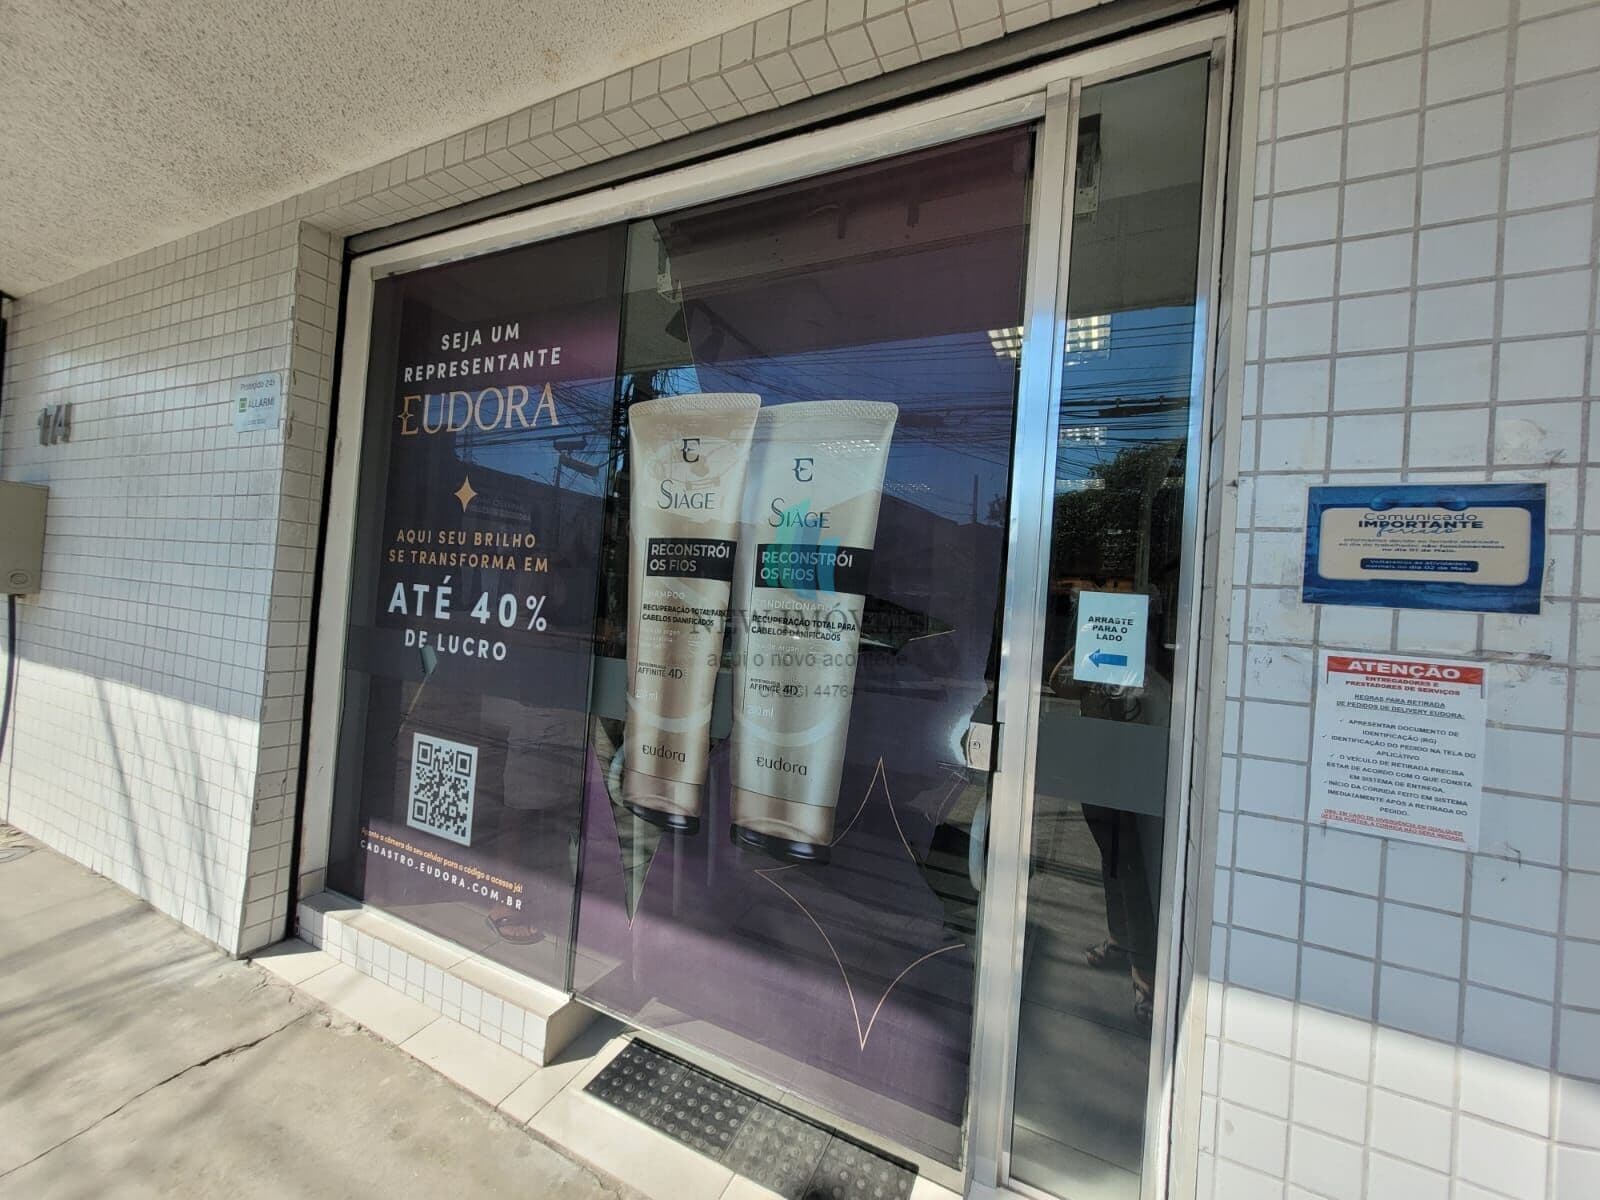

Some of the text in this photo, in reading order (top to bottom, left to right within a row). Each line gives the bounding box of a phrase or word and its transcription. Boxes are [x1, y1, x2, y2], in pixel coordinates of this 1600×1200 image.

[441, 323, 520, 351] SEJA UM
[404, 346, 562, 382] REPRESENTANTE
[398, 382, 560, 435] EUDORA
[1358, 520, 1484, 529] IMPORTANTE
[1364, 512, 1477, 521] Comunicado
[396, 529, 536, 549] AQUI SEU BRILHO
[650, 543, 730, 559] RECONSTRÓI
[389, 550, 548, 573] SE TRANSFORMA EM
[650, 559, 697, 572] OS FIOS
[761, 551, 853, 568] RECONSTRÓI
[760, 568, 815, 582] OS FIOS
[388, 576, 547, 632] ATÉ 40%
[812, 620, 836, 630] TOTAL
[838, 623, 856, 632] PARA
[1088, 616, 1134, 626] ARRASTE
[1092, 624, 1117, 633] PARA
[404, 629, 507, 661] DE LUCRO
[1096, 634, 1123, 642] LADO
[1348, 660, 1461, 681] ATENÇÃO
[1346, 681, 1402, 690] PRESTADORES
[1418, 686, 1460, 696] SERVIÇOS
[1366, 676, 1430, 686] ENTREGADORES
[1349, 720, 1396, 730] APRESENTAR
[1398, 726, 1446, 736] DOCUMENTO
[1362, 730, 1418, 742] IDENTIFICAÇÃO
[1331, 735, 1385, 747] IDENTIFICAÇÃO
[1400, 744, 1428, 752] PEDIDO
[1443, 750, 1463, 758] TELA
[1376, 751, 1420, 761] APLICATIVO
[1346, 755, 1378, 764] VEÍCULO
[1392, 762, 1429, 772] RETIRADA
[1430, 768, 1464, 776] PRECISA
[1327, 762, 1350, 770] ESTAR
[1362, 767, 1394, 776] ACORDO
[1440, 778, 1472, 788] CONSTA
[1362, 776, 1393, 786] SISTEMA
[1328, 789, 1384, 803] IMEDIATAMENTE
[1416, 804, 1454, 814] RETIRADA
[1363, 785, 1396, 795] CORRIDA
[1398, 790, 1420, 799] FEITO
[1434, 796, 1468, 806] SISTEMA
